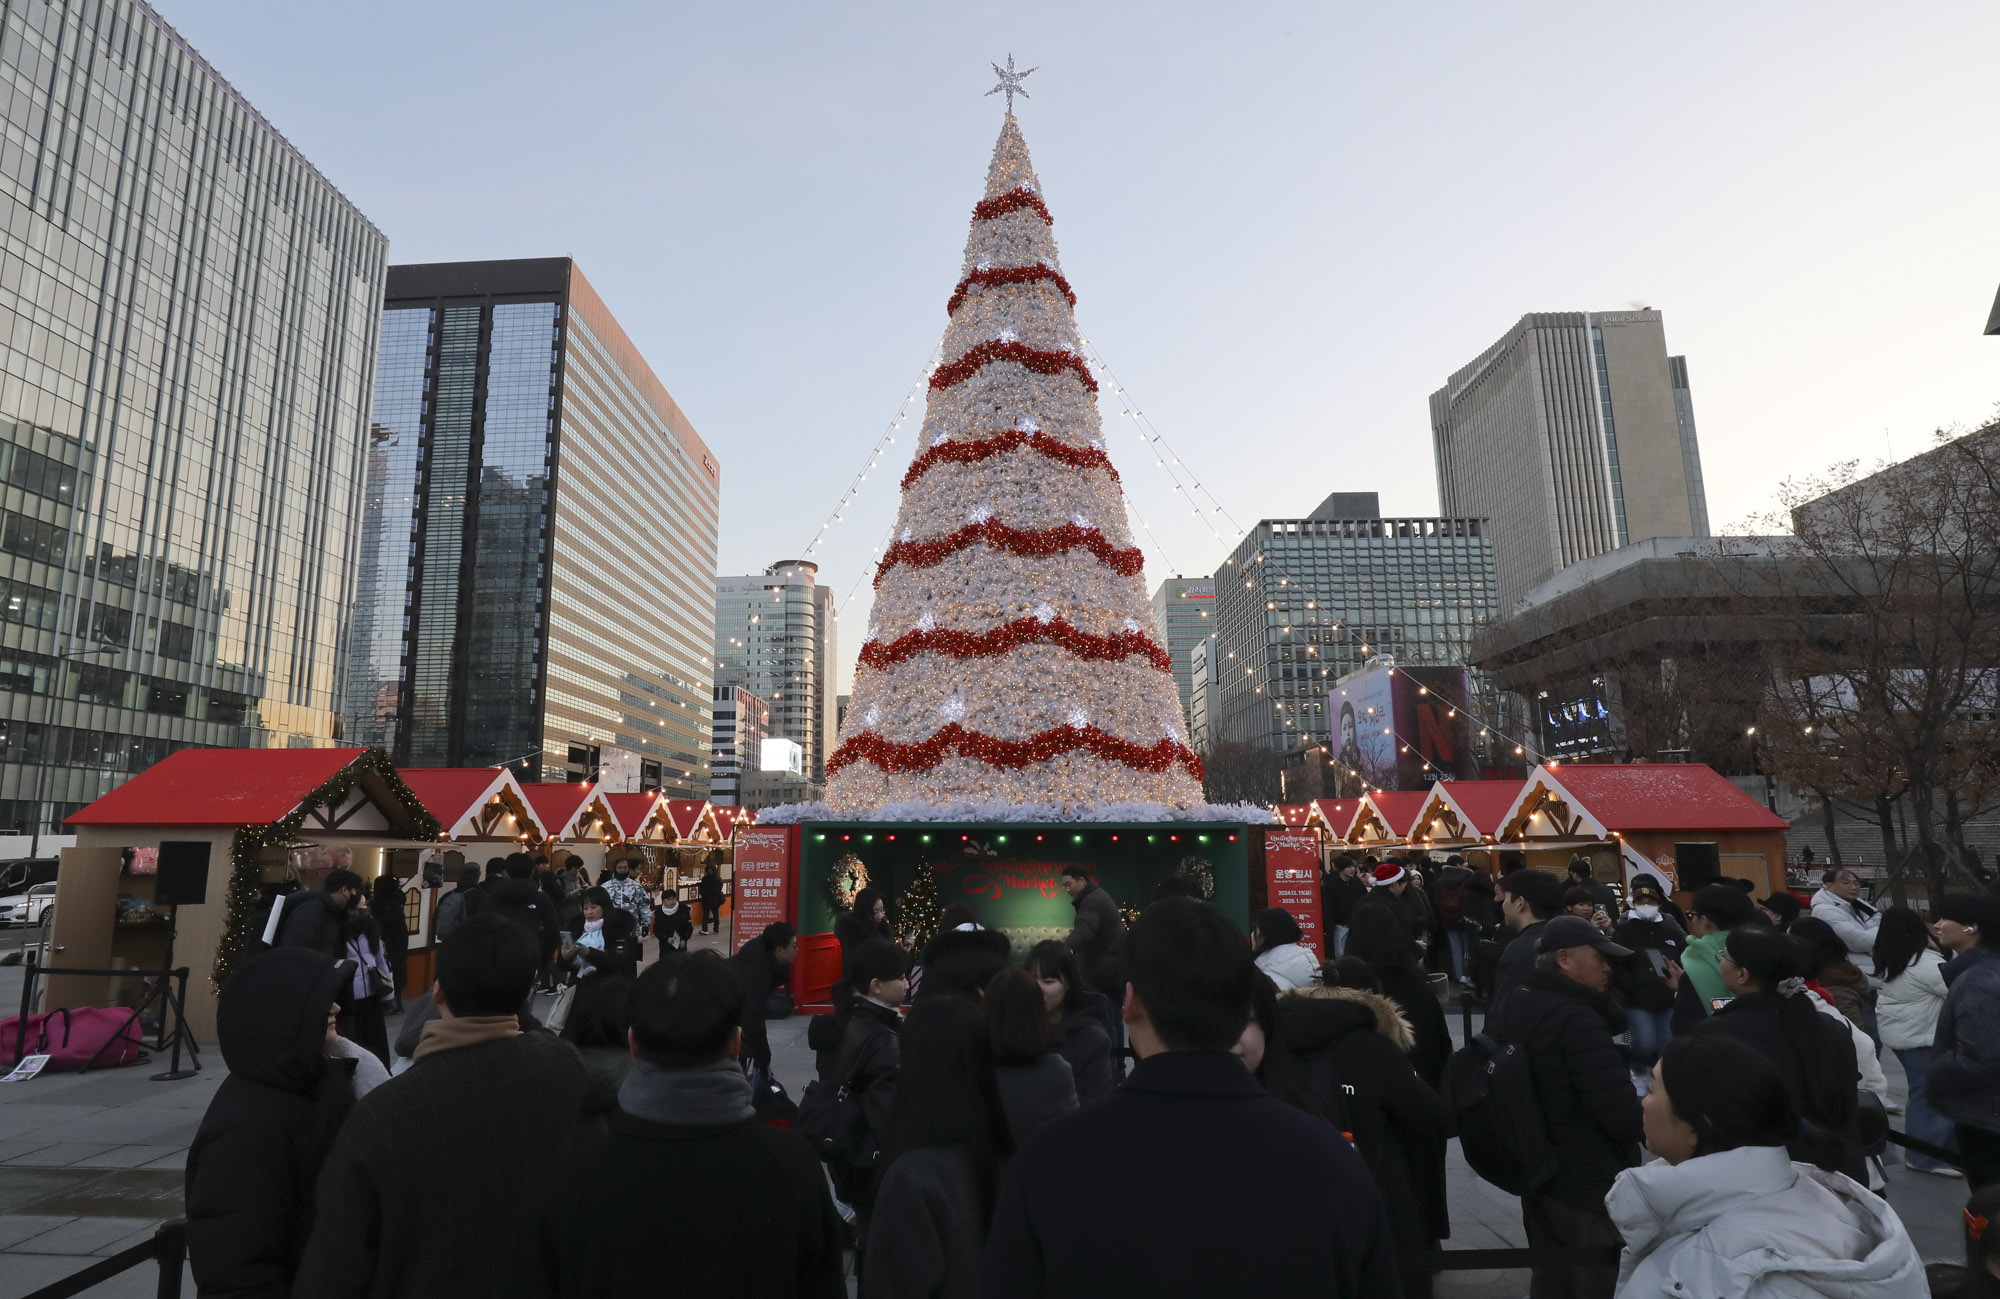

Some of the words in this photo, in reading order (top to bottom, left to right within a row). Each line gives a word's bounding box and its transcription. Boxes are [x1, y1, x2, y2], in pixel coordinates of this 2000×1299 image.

[1275, 869, 1293, 879] 운영
[1295, 869, 1313, 879] 일시
[740, 878, 764, 887] 초상권
[765, 878, 782, 887] 활용
[999, 874, 1058, 899] Market
[743, 888, 760, 898] 동의
[761, 888, 778, 898] 안내
